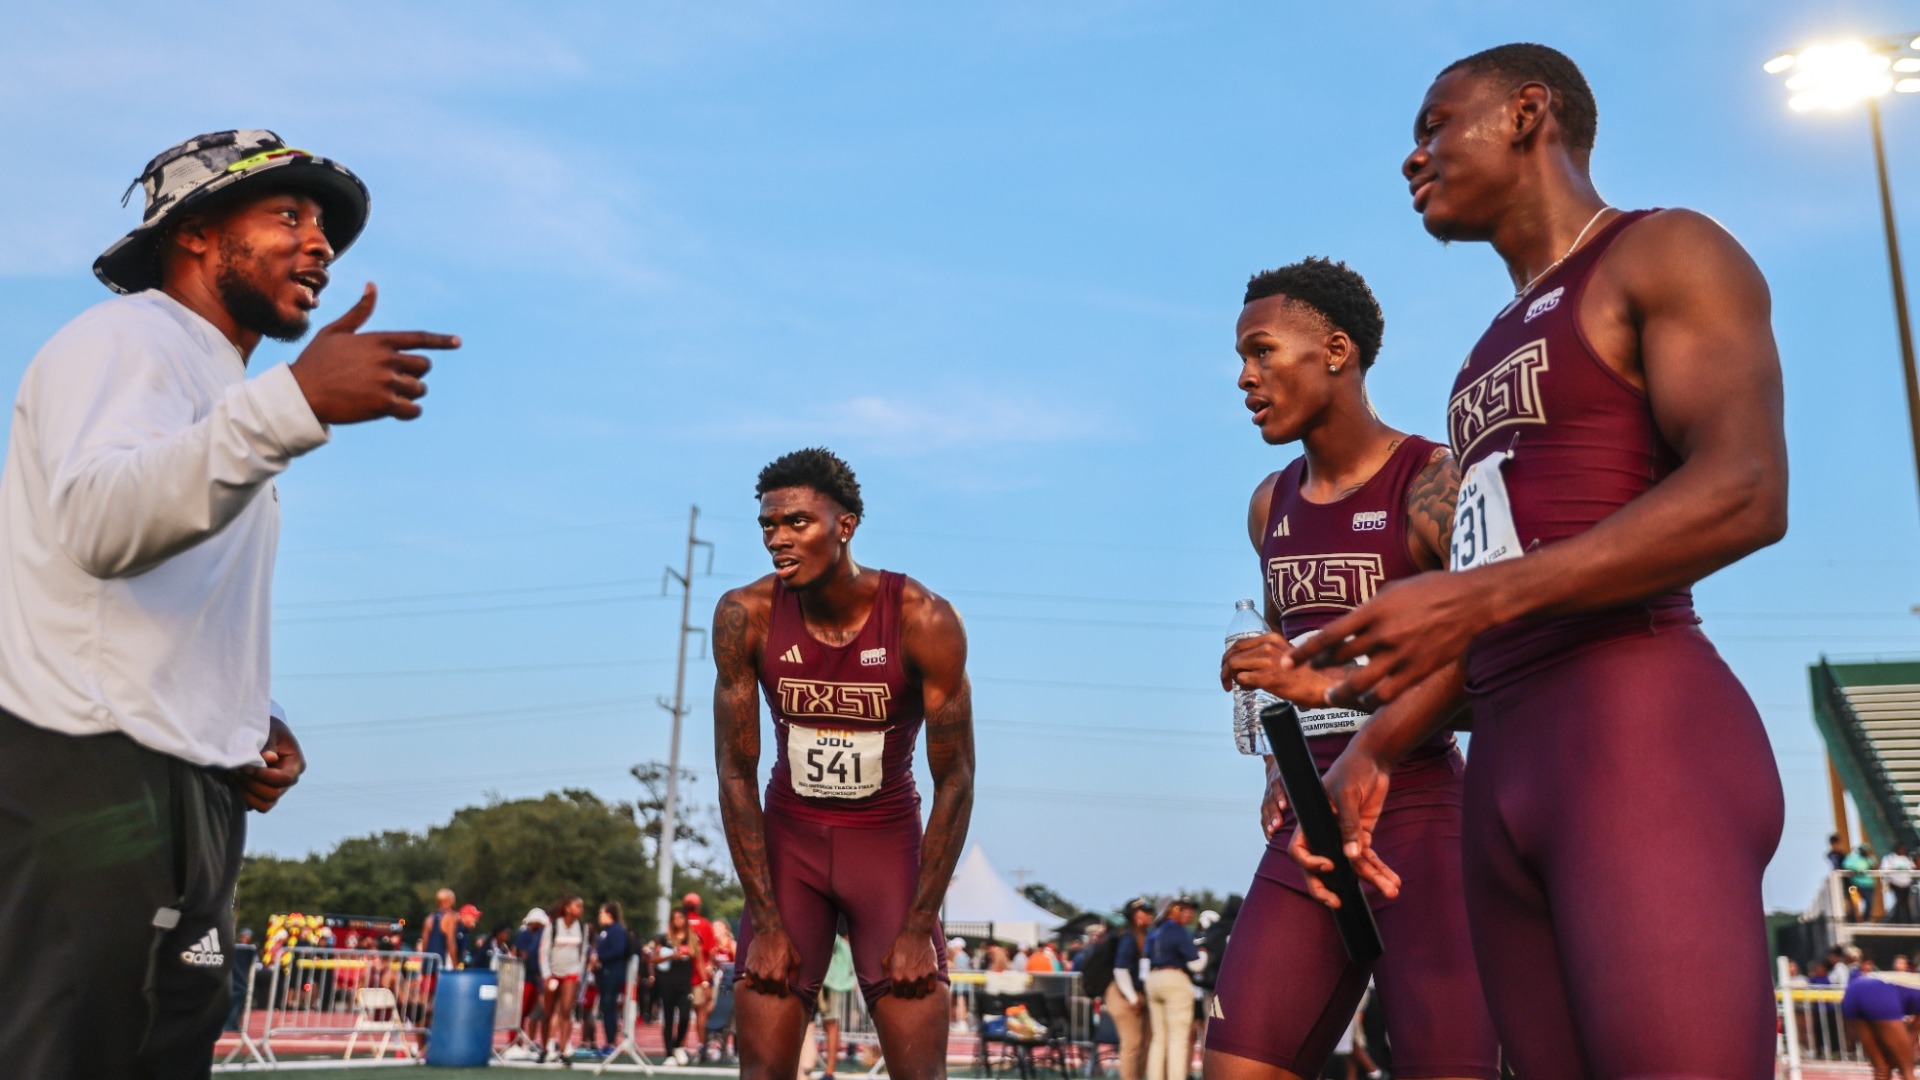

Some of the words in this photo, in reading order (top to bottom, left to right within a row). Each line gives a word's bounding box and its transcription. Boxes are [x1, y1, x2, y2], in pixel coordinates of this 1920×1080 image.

[1353, 511, 1386, 531] SBC
[1268, 555, 1382, 612] TXST
[861, 648, 886, 666] SBC
[778, 678, 890, 720] TXST
[1326, 711, 1349, 719] TRACK
[1303, 720, 1355, 731] CHAMPIONSHIPS
[807, 748, 861, 783] 541
[180, 950, 224, 966] adidas
